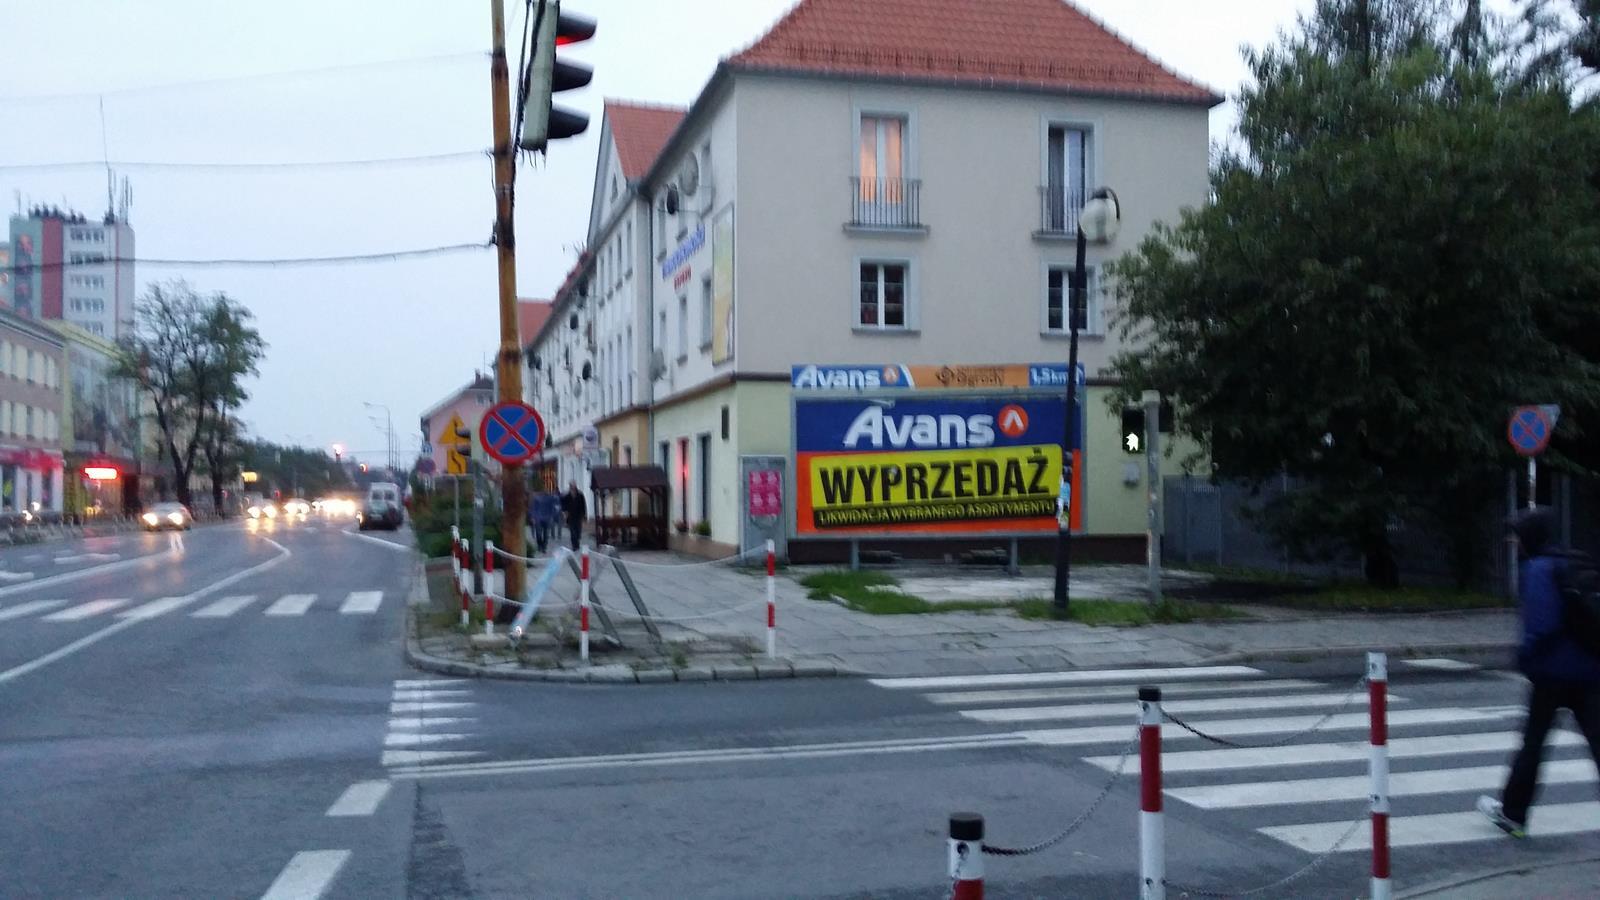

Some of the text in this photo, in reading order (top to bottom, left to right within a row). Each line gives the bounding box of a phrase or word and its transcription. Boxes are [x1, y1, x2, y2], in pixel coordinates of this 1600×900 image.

[795, 364, 881, 388] Avans
[842, 405, 996, 448] Avans
[819, 447, 1050, 505] WYPRZEDAŻ
[819, 500, 1056, 525] LIKWIDACJA WYBRANEGO ASORTYMENTU
